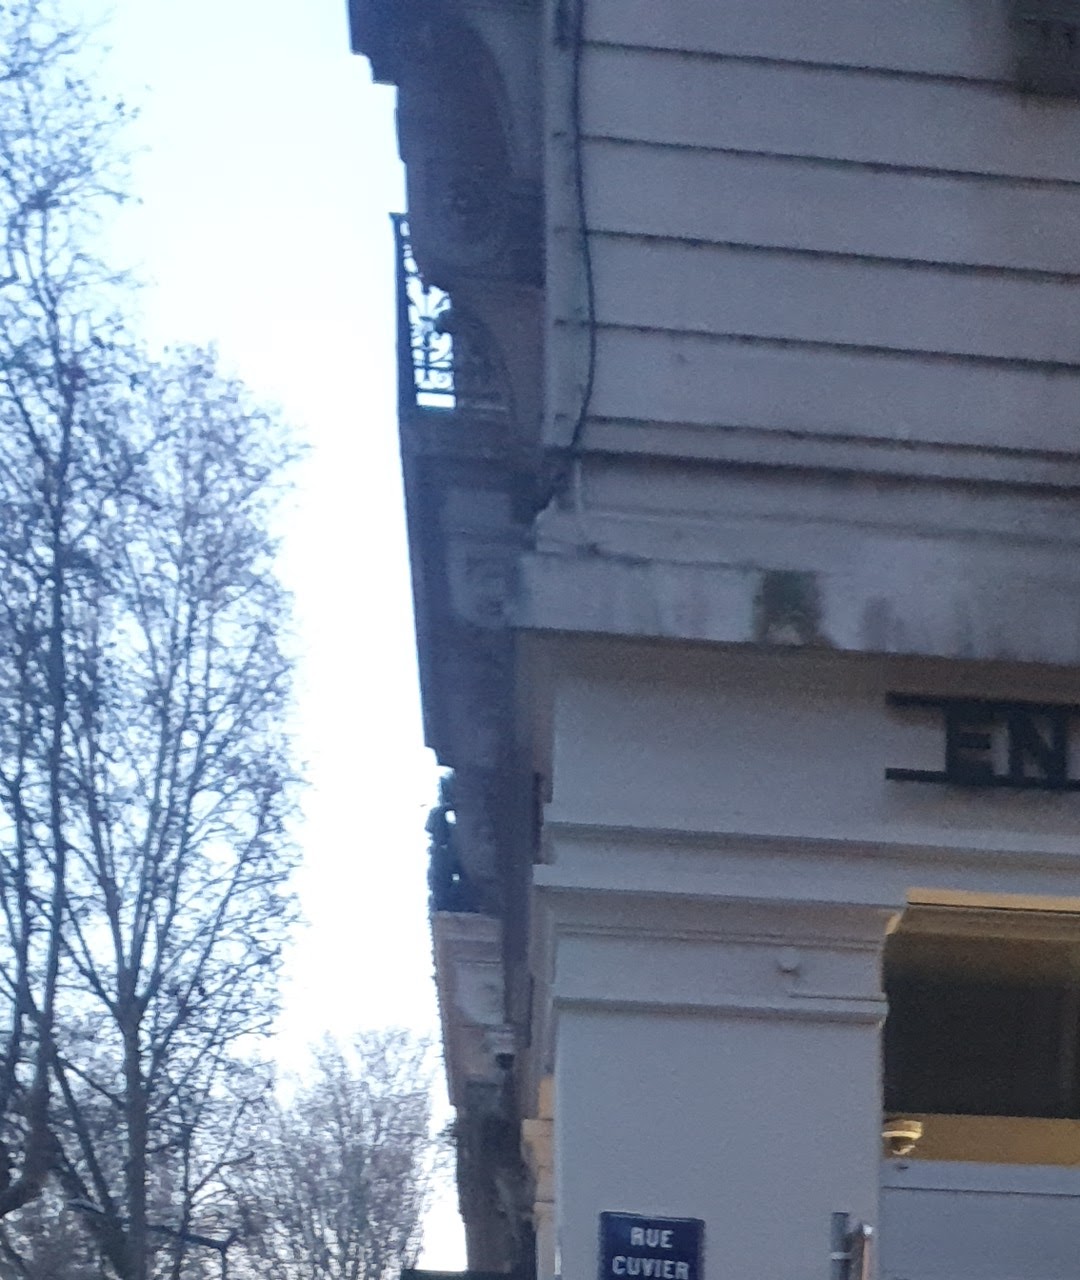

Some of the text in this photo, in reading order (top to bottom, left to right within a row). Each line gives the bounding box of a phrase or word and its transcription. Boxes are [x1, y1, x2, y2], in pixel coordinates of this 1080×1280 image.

[945, 704, 1067, 789] EN
[630, 1227, 674, 1248] RUE
[612, 1255, 690, 1280] CUVIER
